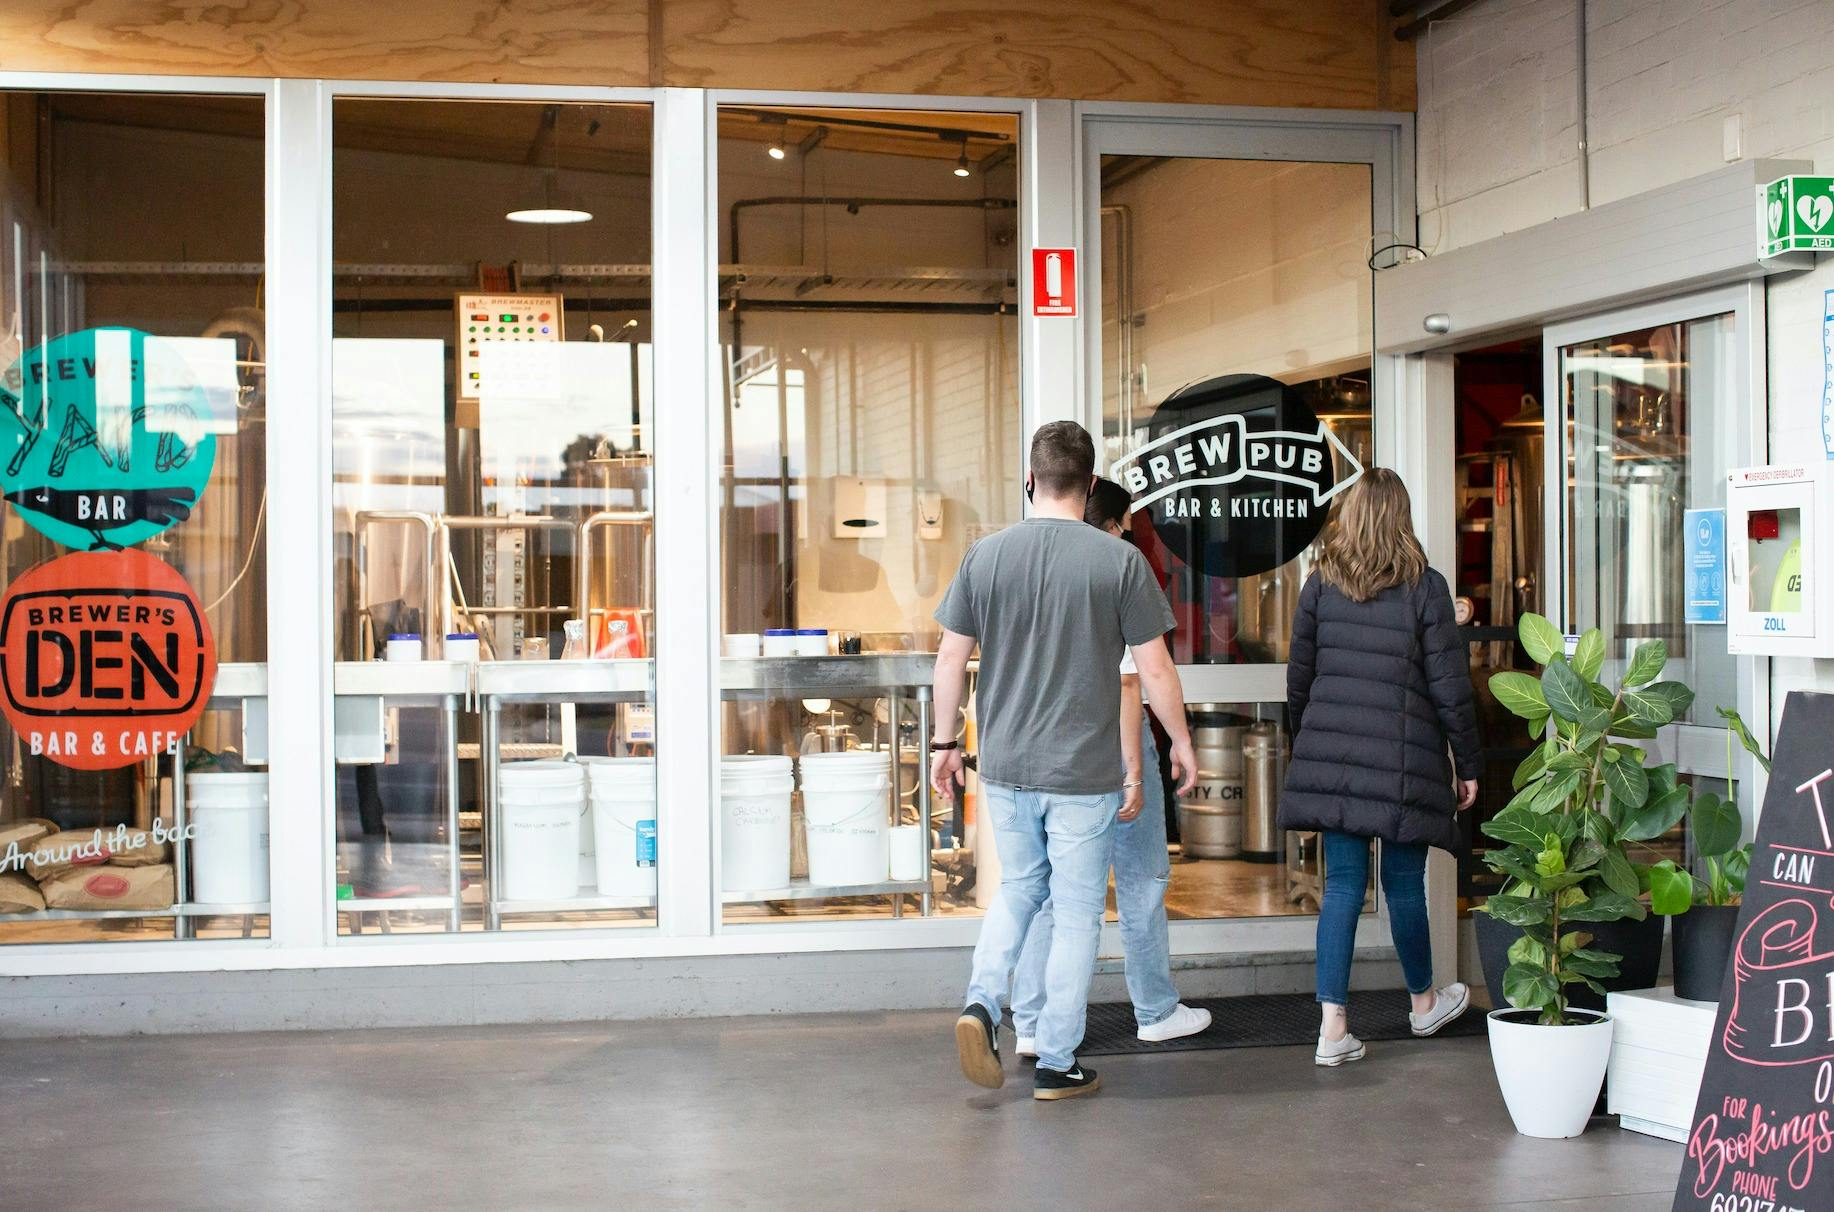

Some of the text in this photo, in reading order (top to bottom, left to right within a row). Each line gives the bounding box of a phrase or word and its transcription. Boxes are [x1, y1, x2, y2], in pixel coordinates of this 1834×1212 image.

[1811, 238, 1832, 248] AED
[1124, 433, 1231, 494] BREW
[1251, 443, 1323, 473] PUB
[77, 495, 127, 520] BAR
[1166, 498, 1308, 518] BAR & KITCHEN
[28, 605, 175, 626] BREWER'S
[1764, 618, 1786, 631] ZOLL
[25, 630, 179, 700] DEN
[30, 731, 177, 755] BAR & CAFE
[0, 828, 104, 874] Around
[106, 823, 147, 854] the
[1772, 852, 1815, 885] CAN
[1722, 1096, 1748, 1119] FOR
[1688, 1103, 1834, 1198] Bookings
[1731, 1170, 1779, 1201] PHONE
